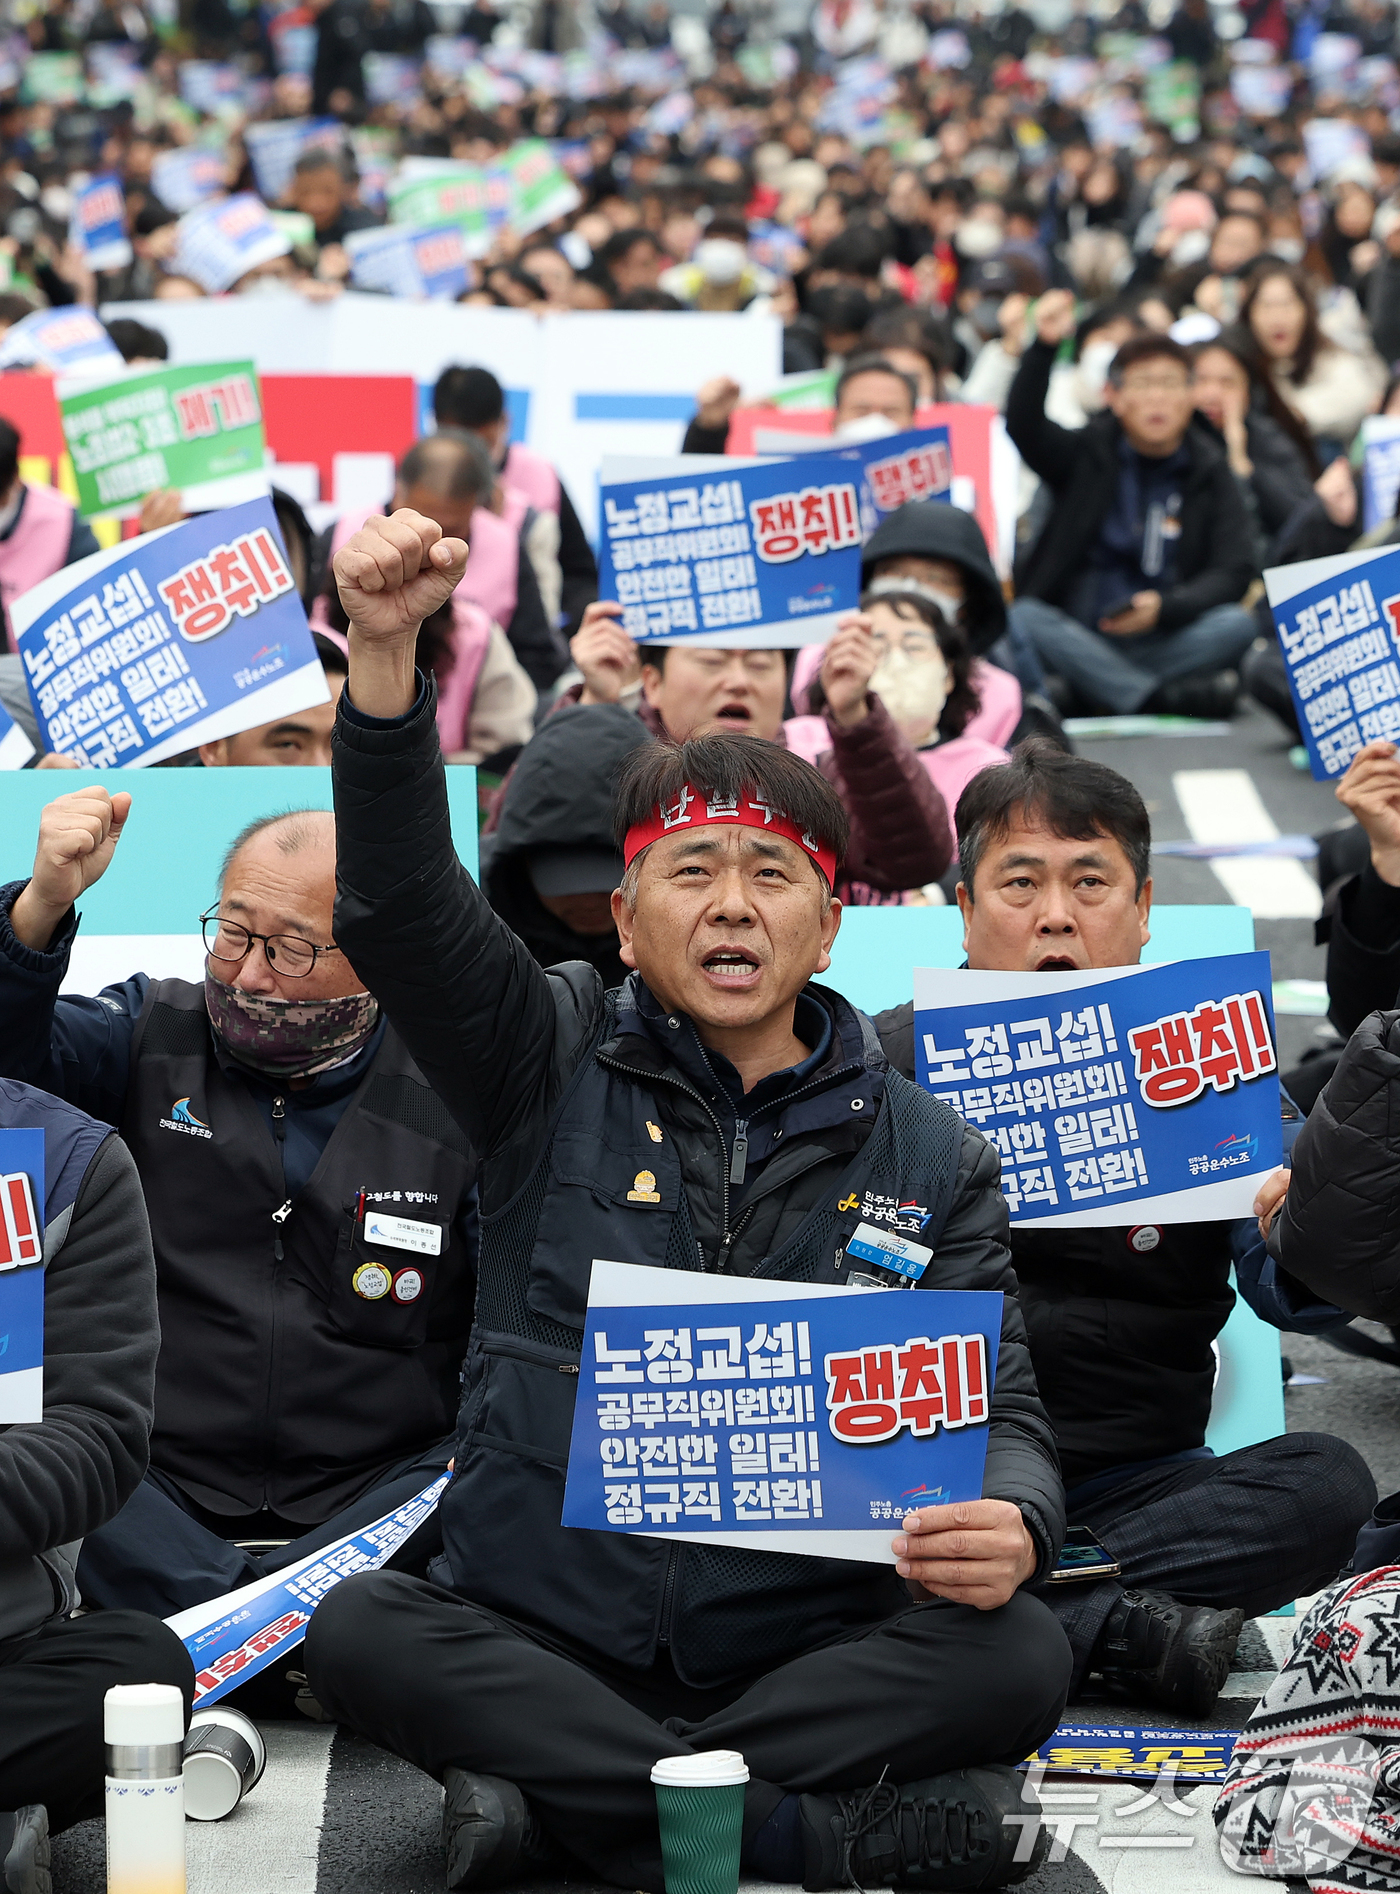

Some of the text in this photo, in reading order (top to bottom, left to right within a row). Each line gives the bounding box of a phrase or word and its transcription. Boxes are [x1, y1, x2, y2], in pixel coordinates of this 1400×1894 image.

[605, 480, 745, 538] 노정교섭!
[751, 483, 862, 564] 쟁취!
[611, 523, 751, 570] 공무직위원회!
[157, 527, 295, 643] 쟁취!
[615, 554, 757, 604] 안전한 일터!
[23, 567, 155, 689] 노정교섭!
[623, 597, 698, 638] 정규직
[700, 587, 762, 628] 전환!
[1278, 579, 1379, 666] 노정교섭!
[37, 611, 172, 720] 공무직위원회!
[1293, 626, 1391, 700] 공무직위원회!
[47, 642, 191, 753] 안전한 일터!
[137, 677, 208, 738] 전환!
[1304, 683, 1353, 738] 안전한
[922, 1002, 1118, 1084] 노정교섭!
[1128, 991, 1276, 1107] 쟁취!
[932, 1061, 1128, 1125] 공무직위원회!
[159, 1118, 214, 1139] 전국철도노동조합
[980, 1102, 1139, 1167] 전한 일터!
[1000, 1147, 1149, 1213] 규직 전환!
[1189, 1151, 1251, 1176] 공공운수노조
[404, 1191, 438, 1203] 향합니다
[861, 1200, 920, 1233] 공공운노조
[865, 1191, 899, 1208] 민주노
[594, 1321, 812, 1385] 노정교섭!
[597, 1385, 815, 1431] 공무직위원회!
[824, 1333, 990, 1443] 쟁취!
[600, 1430, 820, 1478] 안전한 일터!
[604, 1478, 823, 1525] 정규직 전환!
[193, 1609, 311, 1705] 쟁취
